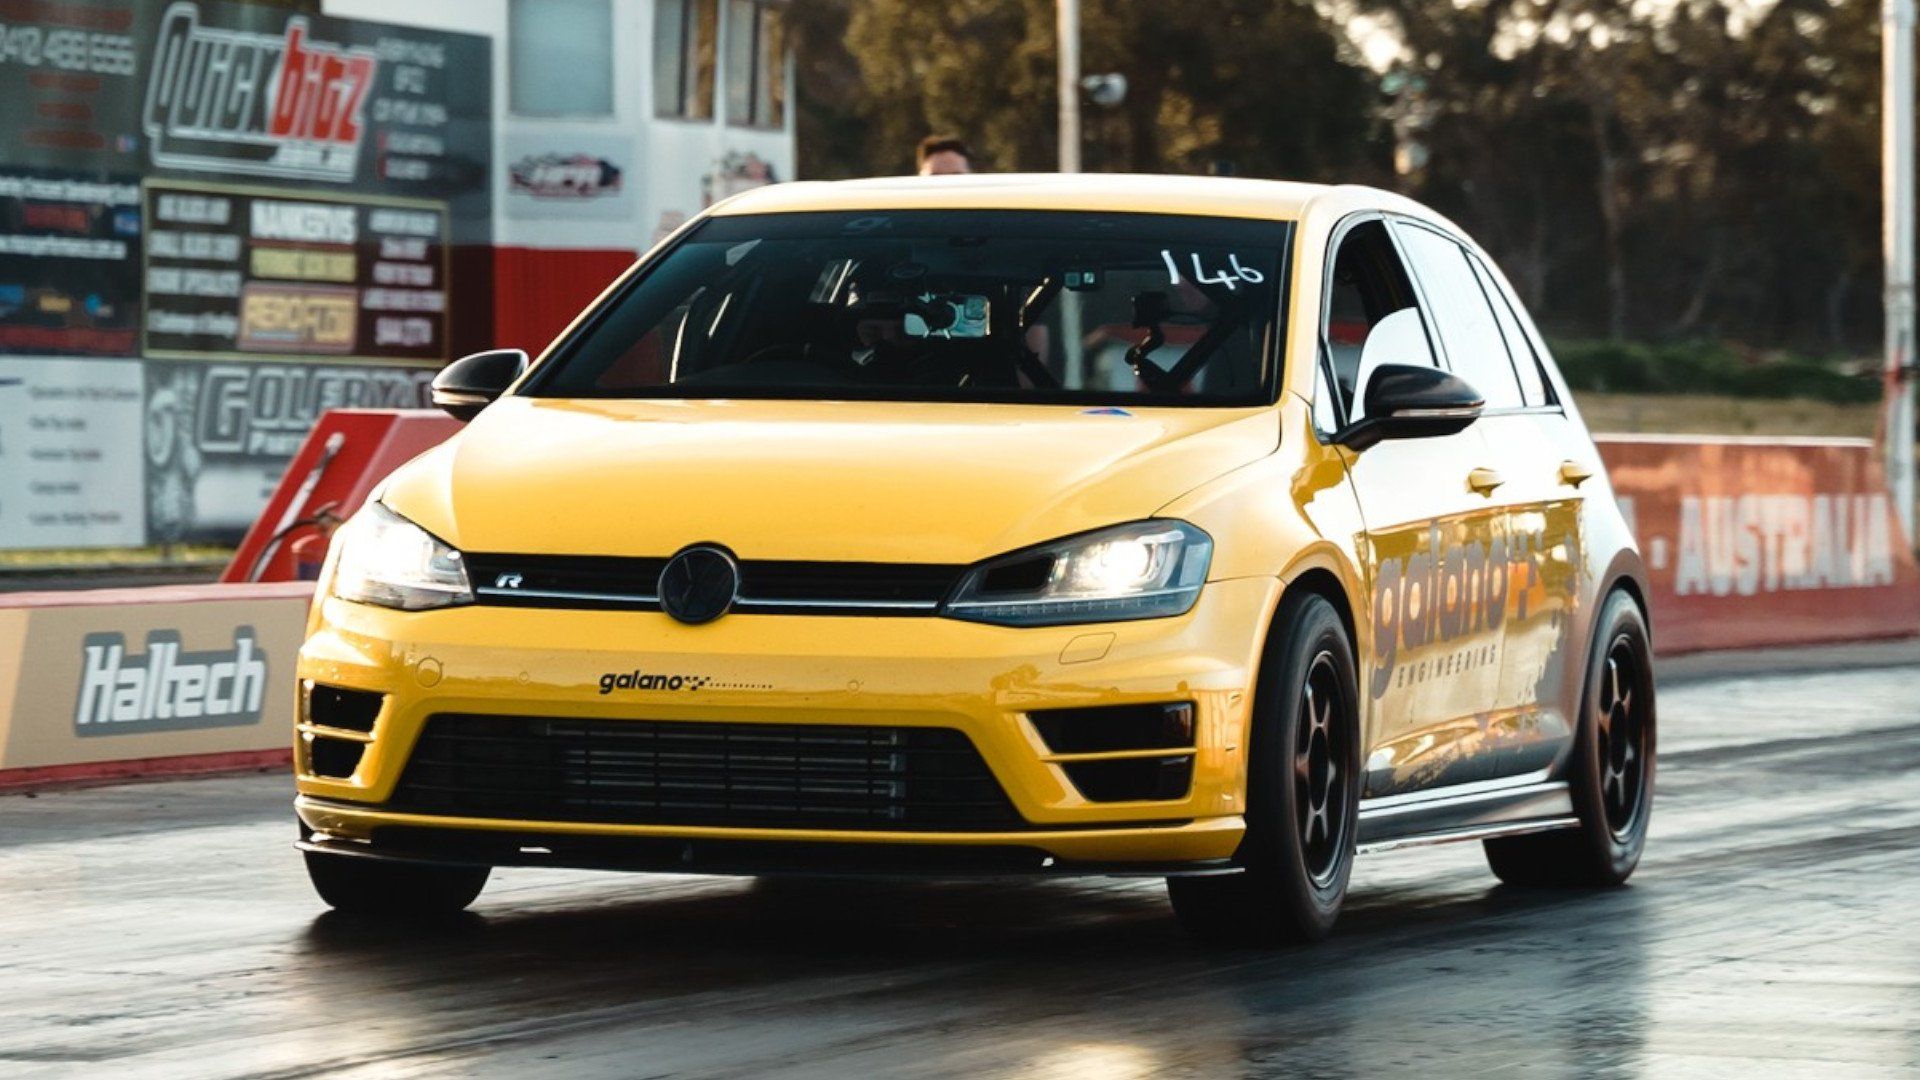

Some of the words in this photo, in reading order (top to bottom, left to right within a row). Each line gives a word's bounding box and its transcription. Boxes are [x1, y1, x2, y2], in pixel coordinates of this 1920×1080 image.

[1160, 249, 1264, 290] 146
[1675, 493, 1893, 596] AUSTRALIA
[495, 571, 523, 589] R
[76, 638, 266, 724] Haltech
[599, 669, 683, 695] galano
[1397, 643, 1497, 687] ENGINEERING
